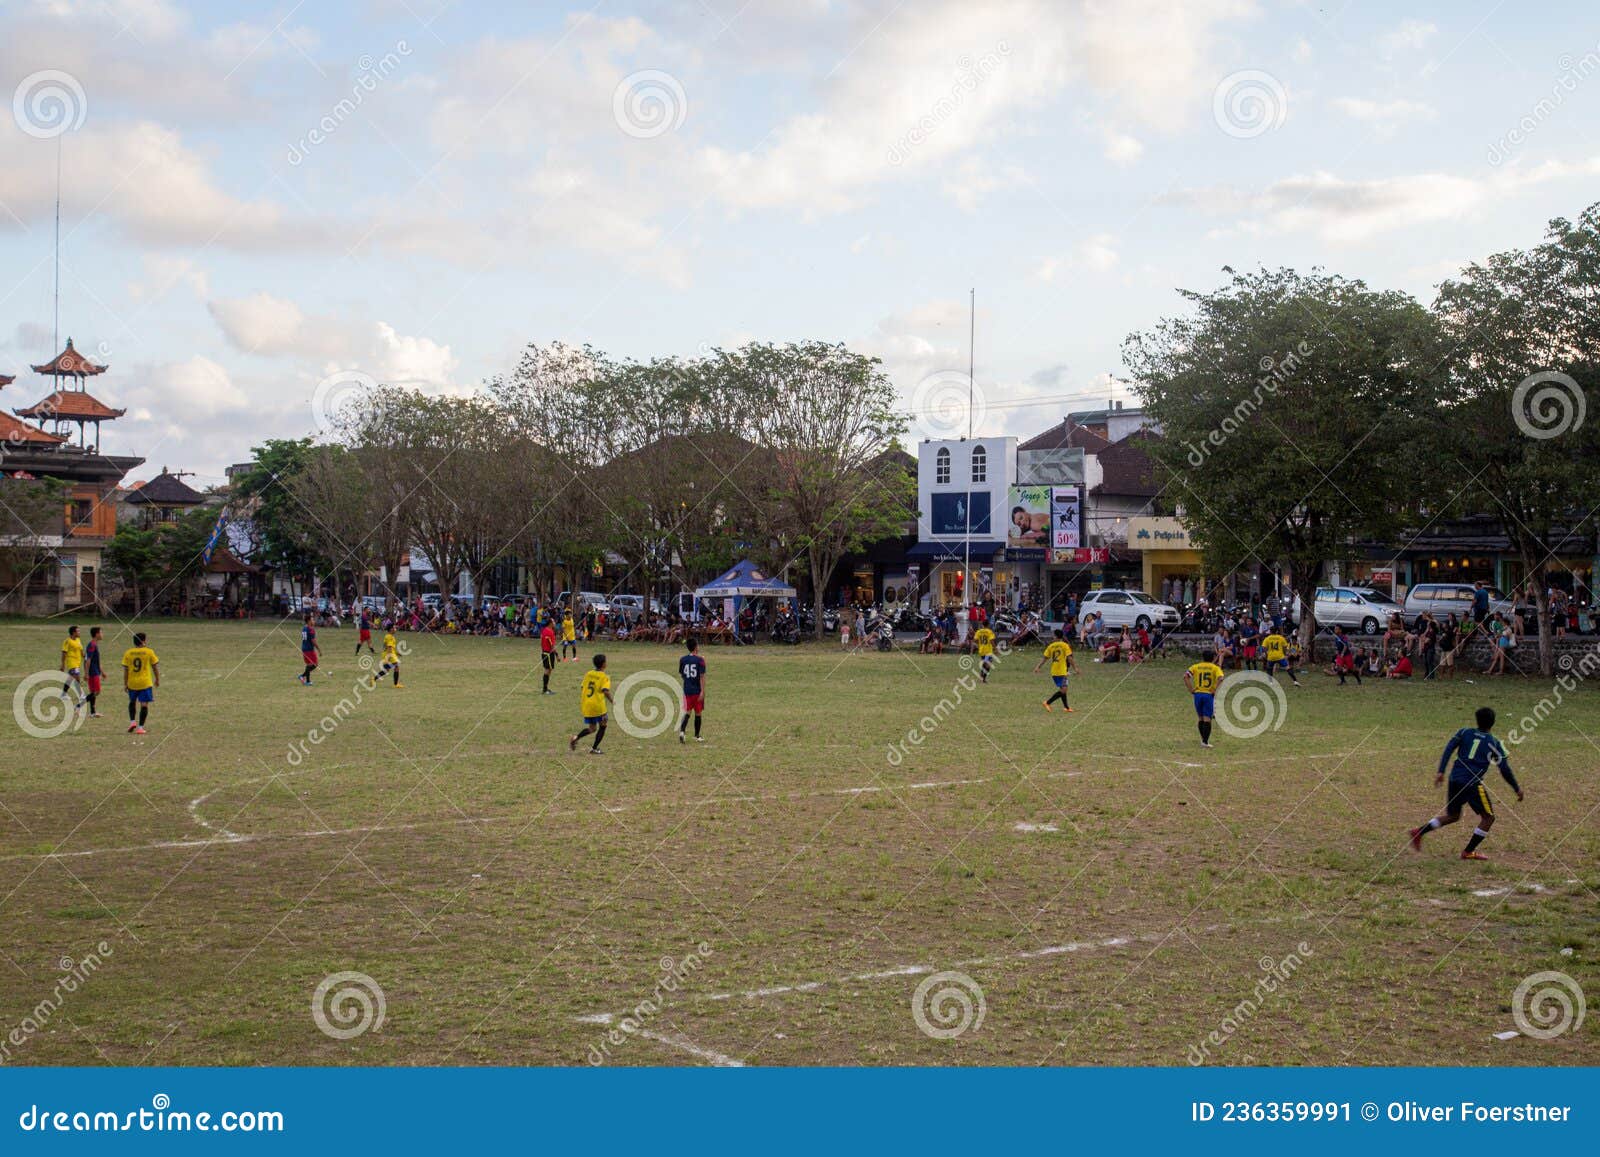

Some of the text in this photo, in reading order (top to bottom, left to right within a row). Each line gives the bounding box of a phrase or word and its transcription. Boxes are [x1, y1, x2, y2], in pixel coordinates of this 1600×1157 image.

[1057, 533, 1079, 545] 50%
[133, 657, 143, 673] 9
[683, 663, 698, 679] 45
[1198, 672, 1212, 688] 15
[586, 681, 596, 698] 5
[1468, 738, 1481, 760] 1
